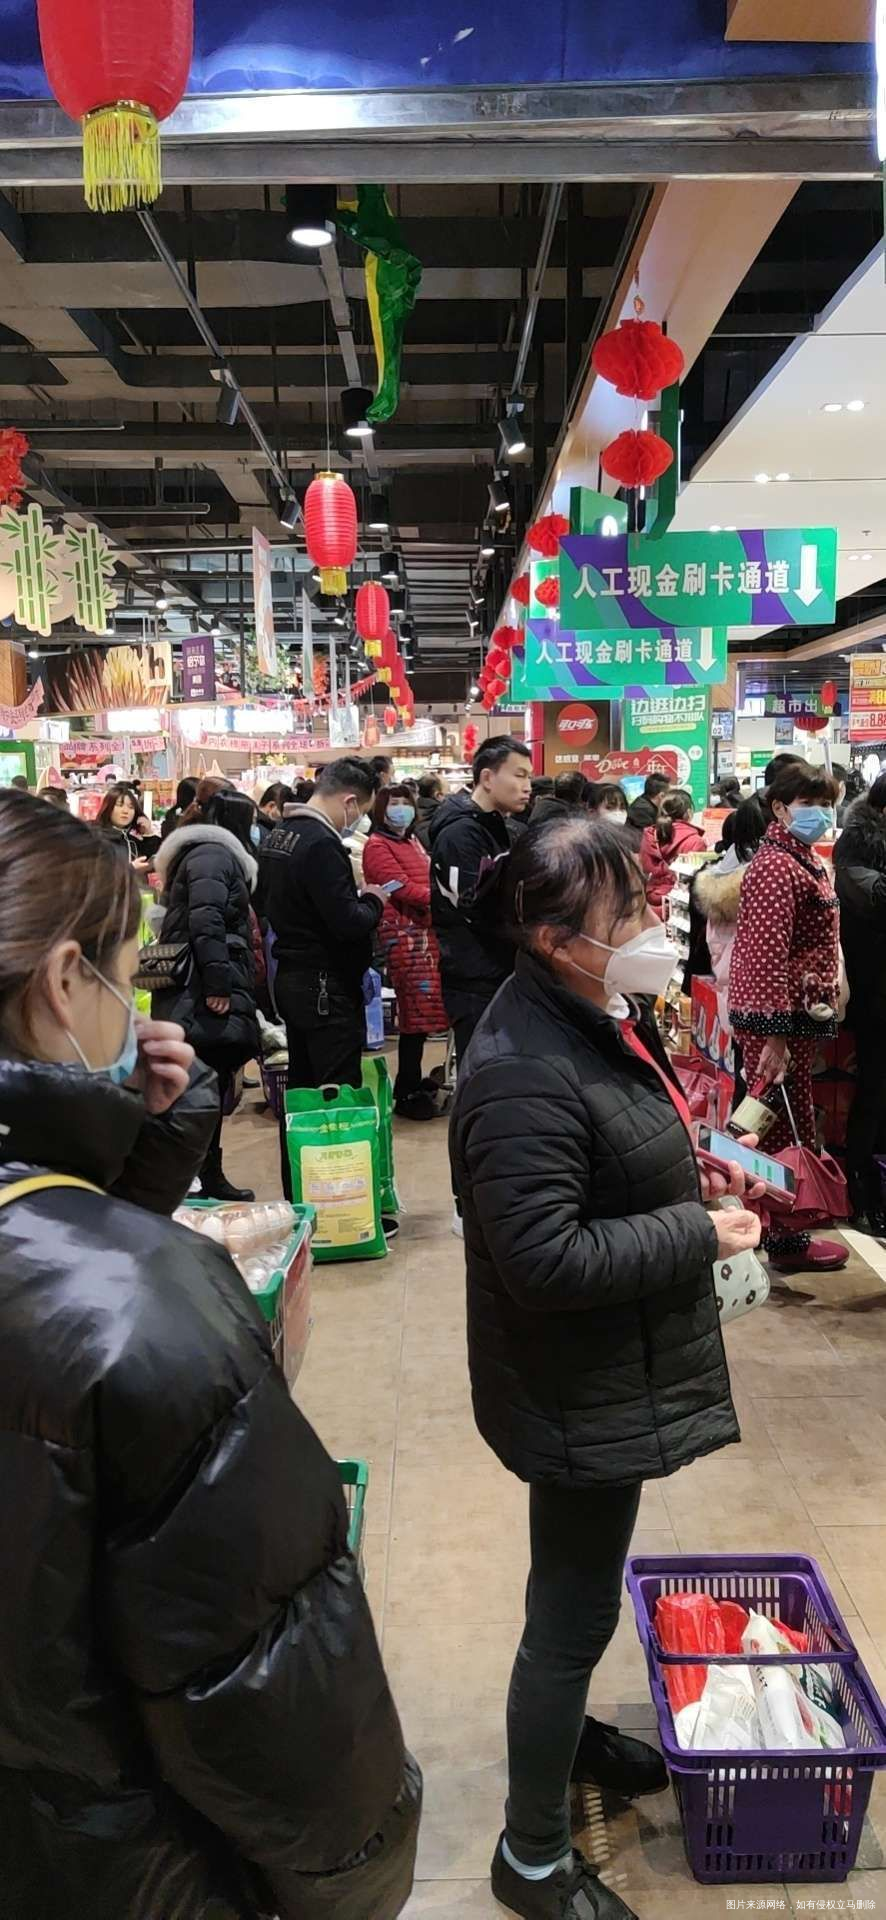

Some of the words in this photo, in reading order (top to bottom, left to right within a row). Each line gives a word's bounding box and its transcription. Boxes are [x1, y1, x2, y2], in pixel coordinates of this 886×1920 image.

[572, 561, 790, 599] 人工现金刷卡通道
[535, 638, 693, 664] 人工现金刷卡通道
